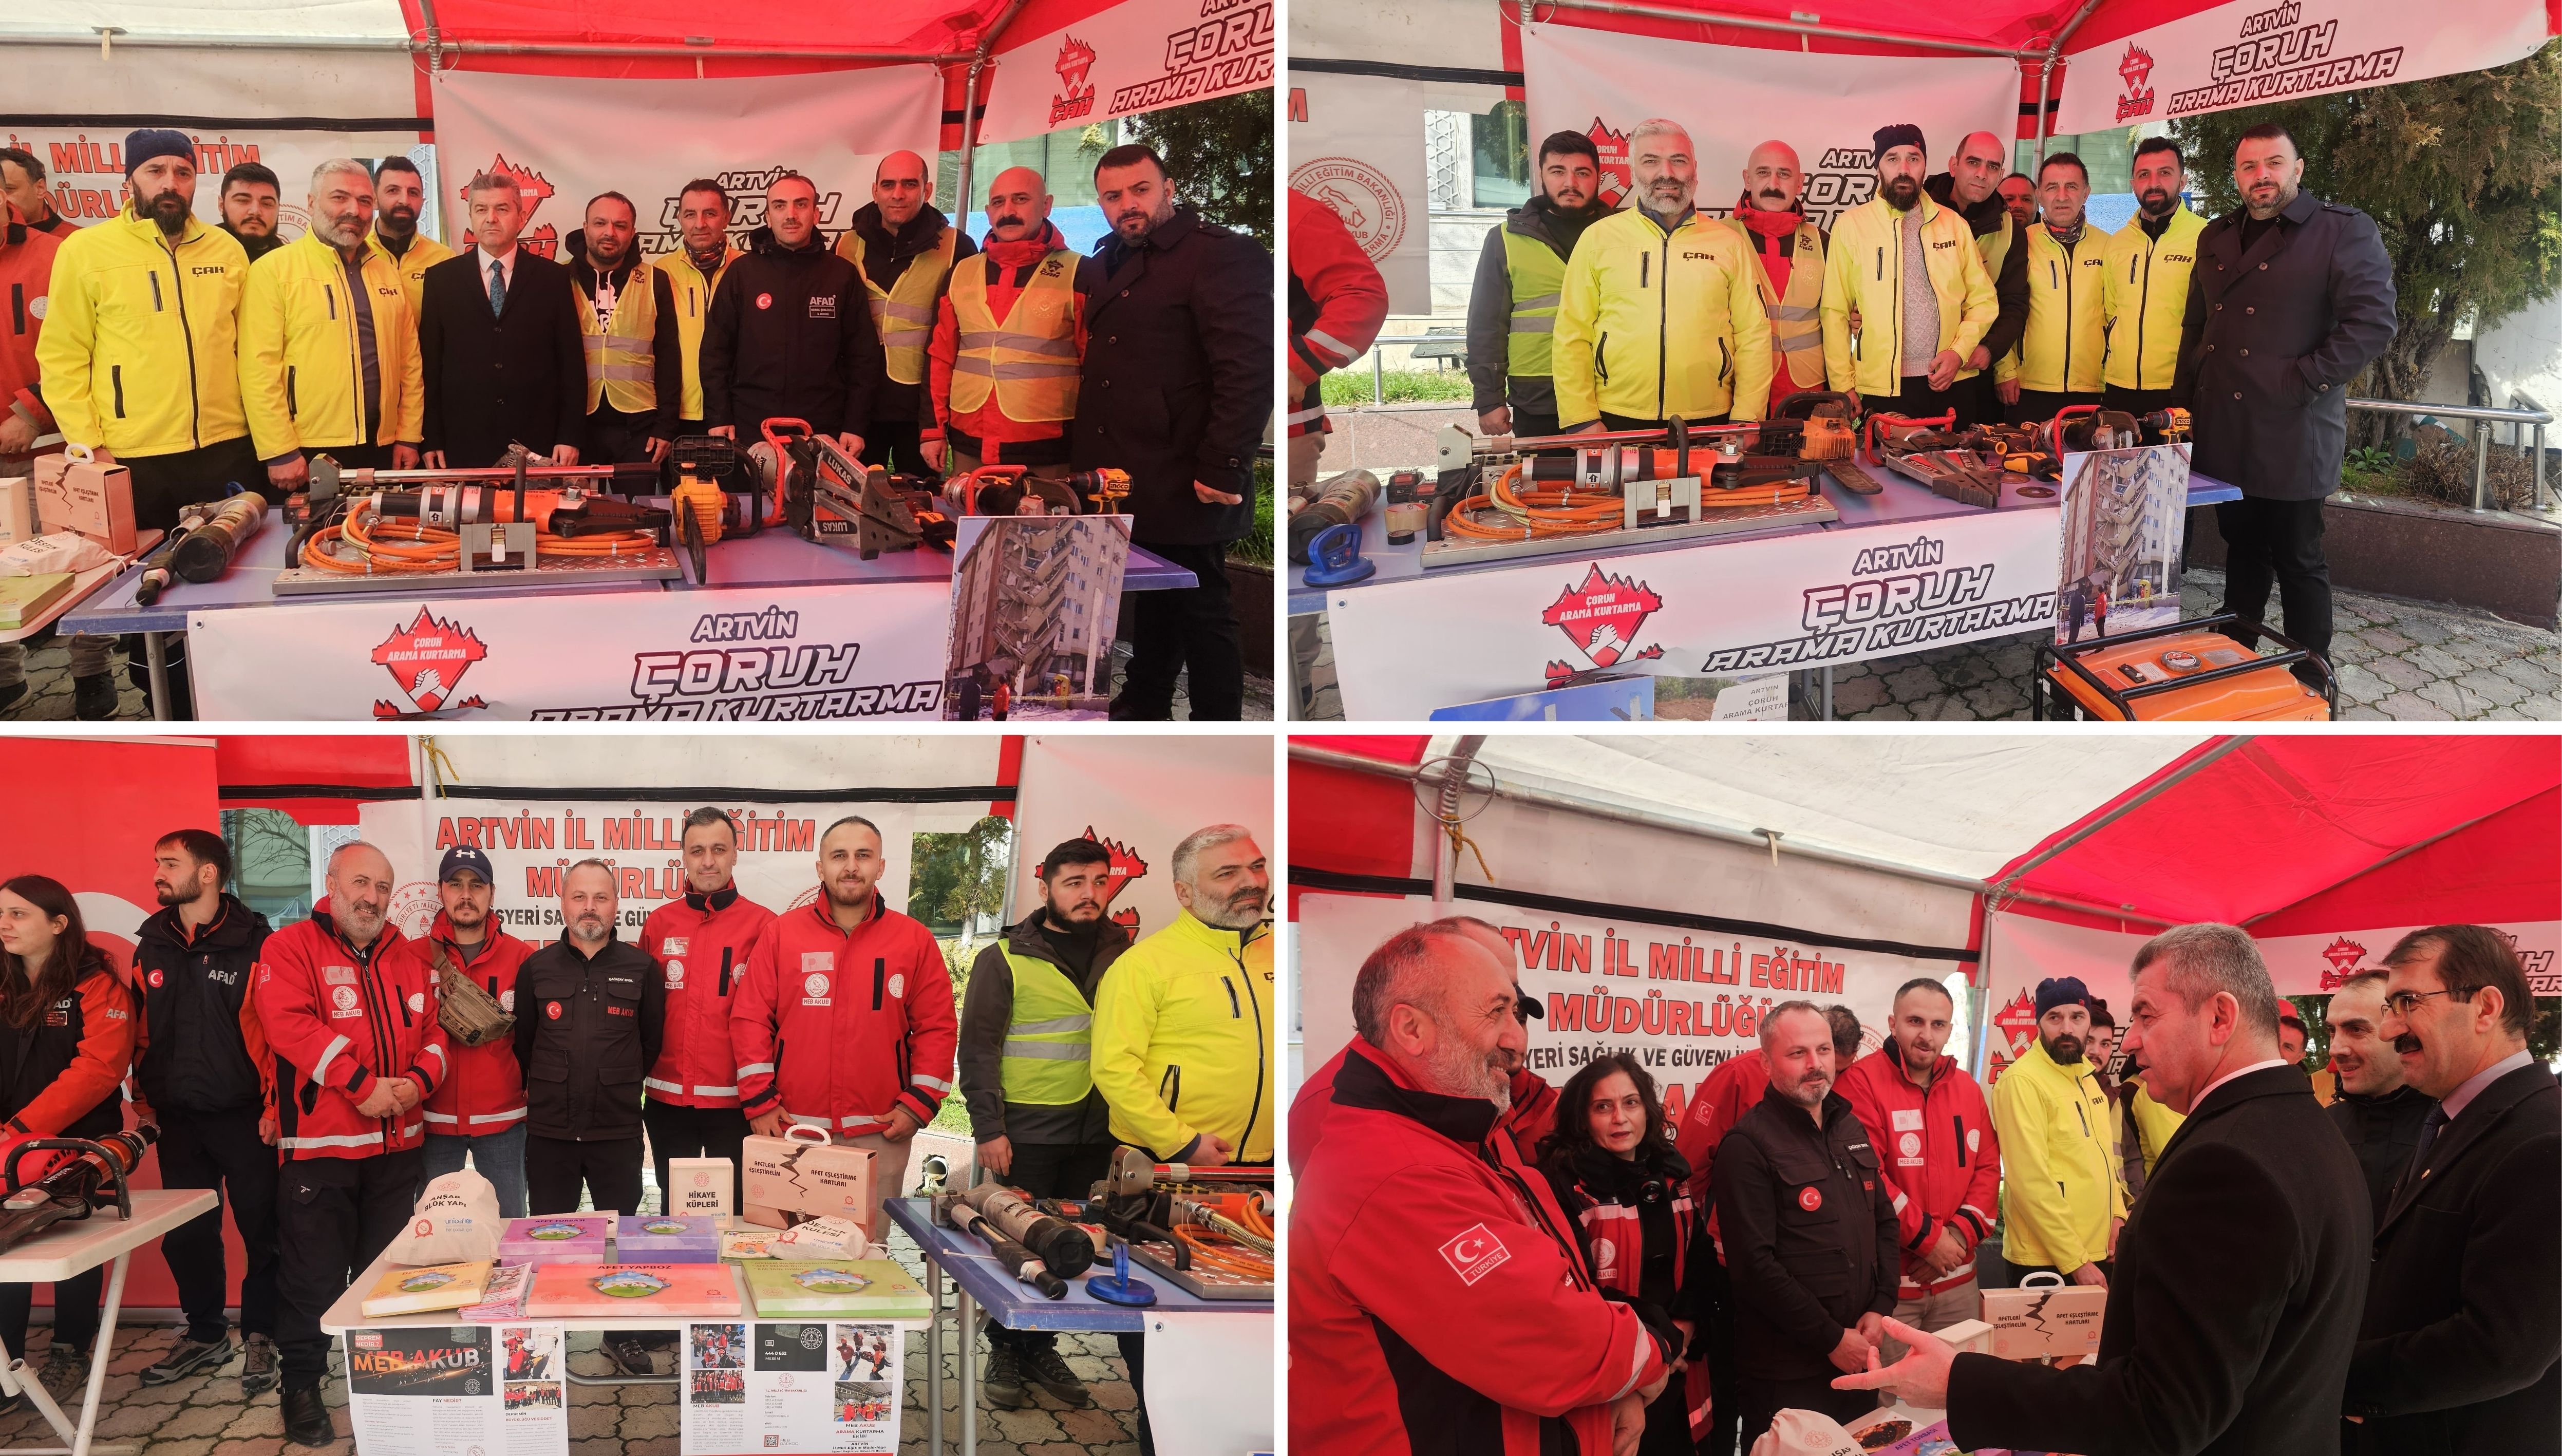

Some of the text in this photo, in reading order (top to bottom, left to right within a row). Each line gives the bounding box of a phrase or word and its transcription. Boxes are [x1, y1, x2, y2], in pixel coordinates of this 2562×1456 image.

[2240, 1, 2302, 38] ARTVİN
[1165, 3, 1274, 75] ÇORU
[2211, 19, 2338, 83] ÇORUH
[2167, 46, 2404, 115] ARAMA KURTARMA
[1108, 67, 1207, 115] ARAMA
[49, 134, 126, 173] MİLL
[1596, 144, 1617, 154] ORUH
[1598, 156, 1629, 165] KURTAR
[519, 188, 538, 197] ARMA
[1317, 167, 1395, 220] EĞİTİM BAKANLIĞI
[1364, 233, 1389, 254] ARMA
[809, 296, 835, 306] AFAD
[1909, 460, 1938, 473] LUKAS
[1961, 455, 1973, 468] LUKAS
[827, 455, 852, 485] LUKAS
[823, 521, 848, 532] LUKAS
[1852, 536, 1944, 576] ARTVİN
[1585, 592, 1616, 608] ÇORUH
[1802, 564, 1995, 634] ÇORUH
[1560, 600, 1642, 621] ARAMA KURTARMA
[691, 605, 798, 642] ARTVİN
[1701, 592, 2057, 673] ARAMA KURTARMA
[413, 636, 442, 651] ÇORUH
[387, 648, 466, 661] ARAMA KURTARMA
[631, 643, 860, 704] ÇORUH
[1750, 684, 1779, 695] ARTVİN
[704, 680, 943, 721] KURTARMA
[1748, 696, 1779, 707] ÇORUH
[1723, 708, 1753, 719] ARAMA
[436, 808, 816, 853] ARTVİN İL ĞİTİM
[1501, 921, 1845, 994] TVİN İL MİLLİ EĞİTİM
[208, 969, 235, 985] AFAD
[54, 999, 71, 1009] AD
[608, 1006, 634, 1017] MEB AKUB
[1524, 1042, 1666, 1070] YERİ VE
[42, 1167, 73, 1184] holmatro
[749, 1167, 781, 1177] EŞLEŞTİRELİM
[824, 1171, 857, 1181] EŞLEŞTİRME
[820, 1178, 846, 1187] KARTLARI
[1863, 1181, 1874, 1190] MEB
[688, 1190, 716, 1199] HİKAYE
[425, 1201, 445, 1212] BLOK
[686, 1200, 719, 1208] KÜPLERİ
[802, 1225, 841, 1238] KULESİ
[805, 1220, 847, 1234] DESTEK
[1470, 1252, 1503, 1277] TÜRKİYE
[1597, 1270, 1616, 1278] AKUB
[1895, 1428, 1938, 1451] AFET TORBASI
